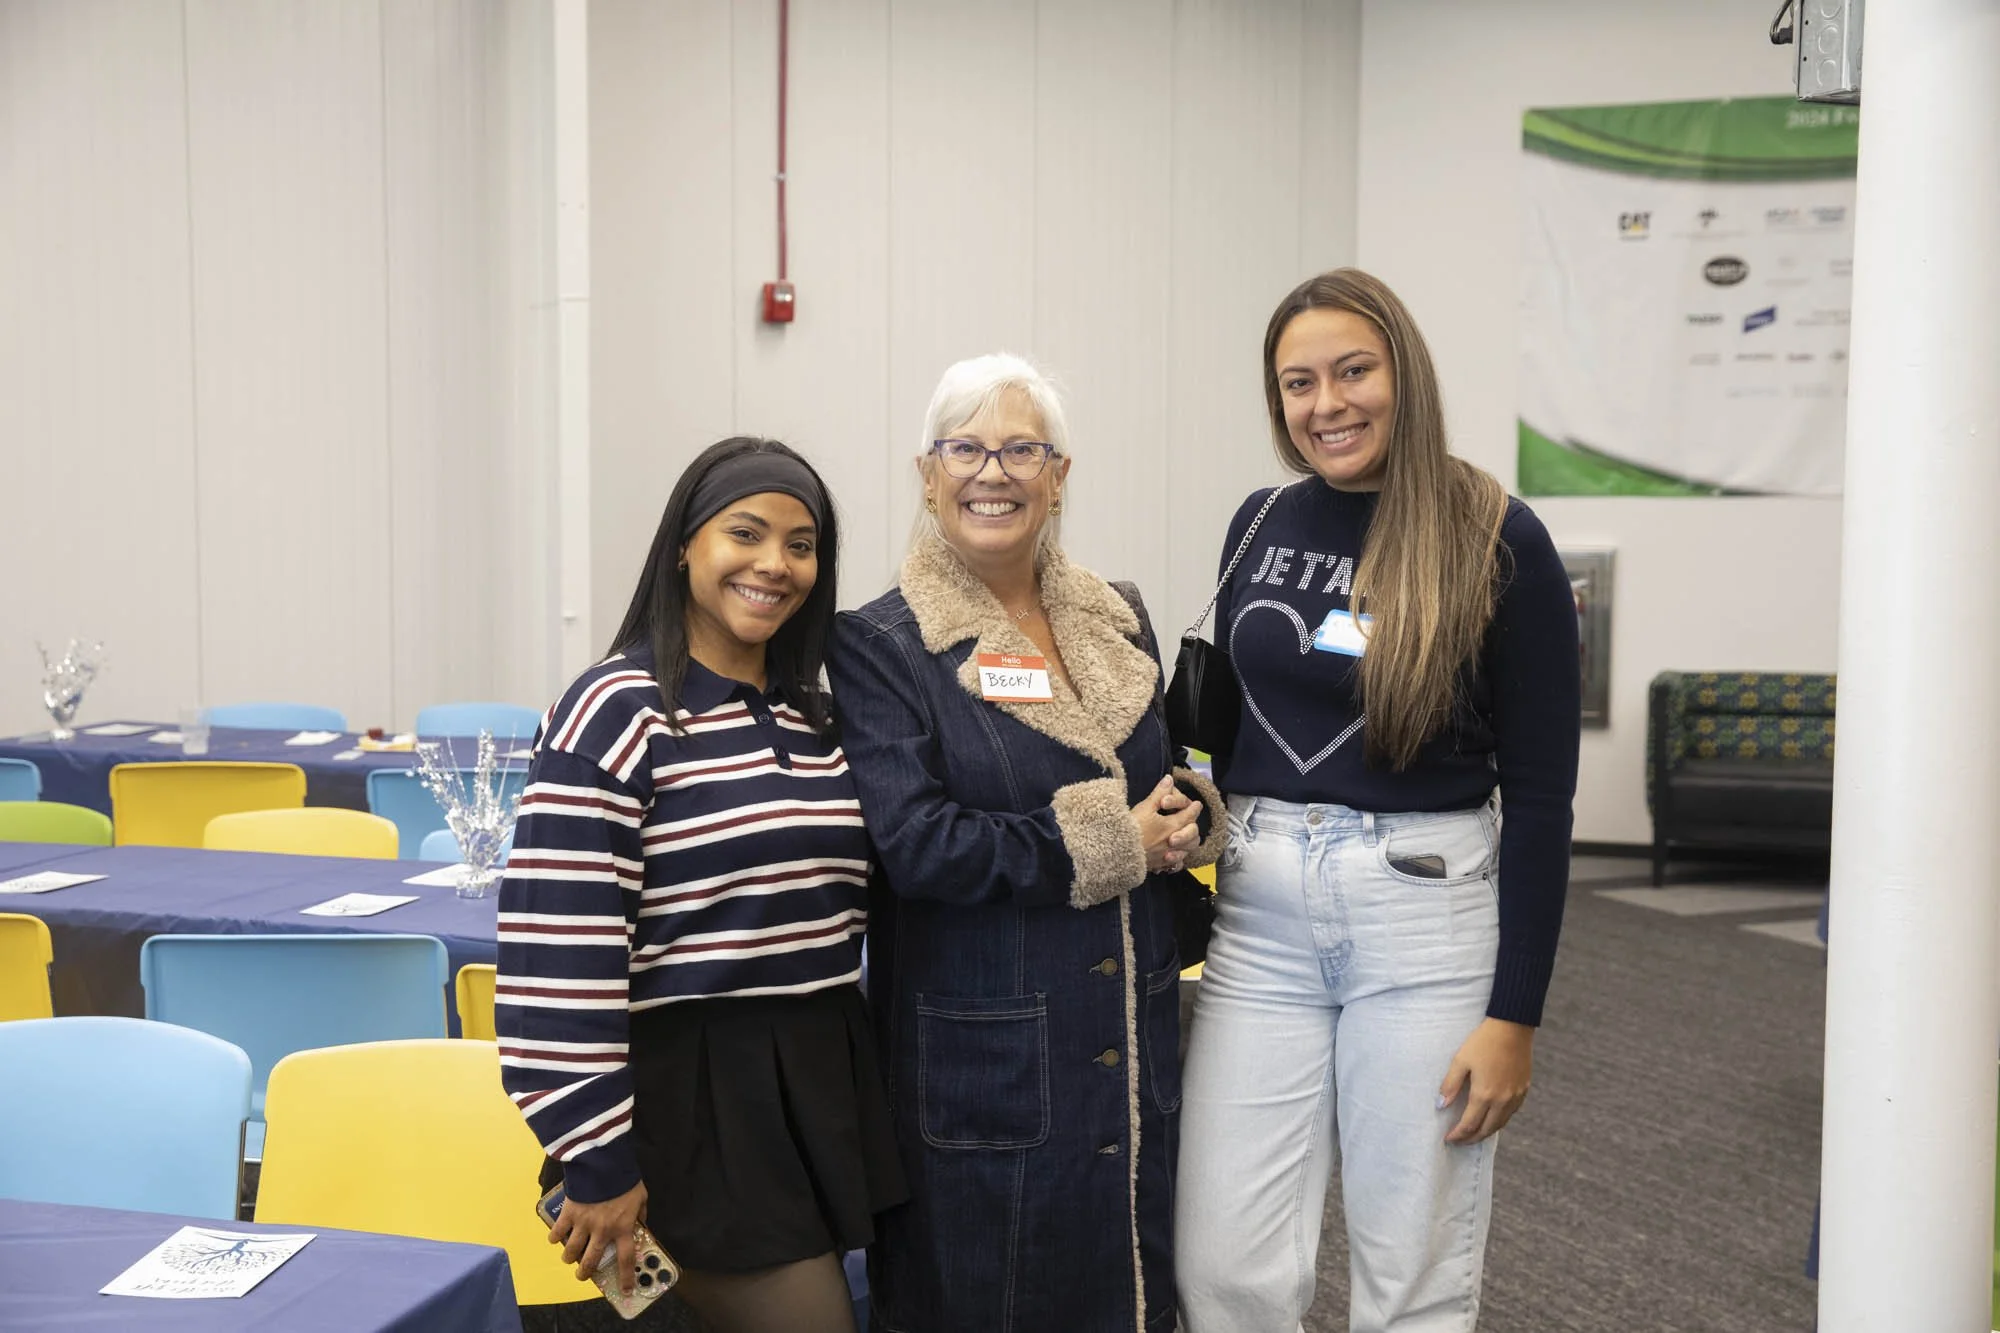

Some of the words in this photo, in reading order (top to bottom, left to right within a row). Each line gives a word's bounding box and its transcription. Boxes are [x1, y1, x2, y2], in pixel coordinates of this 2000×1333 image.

[1251, 546, 1295, 586] JE
[1297, 551, 1367, 597] T'A
[1001, 655, 1022, 665] Hello
[985, 672, 1033, 689] BECKY
